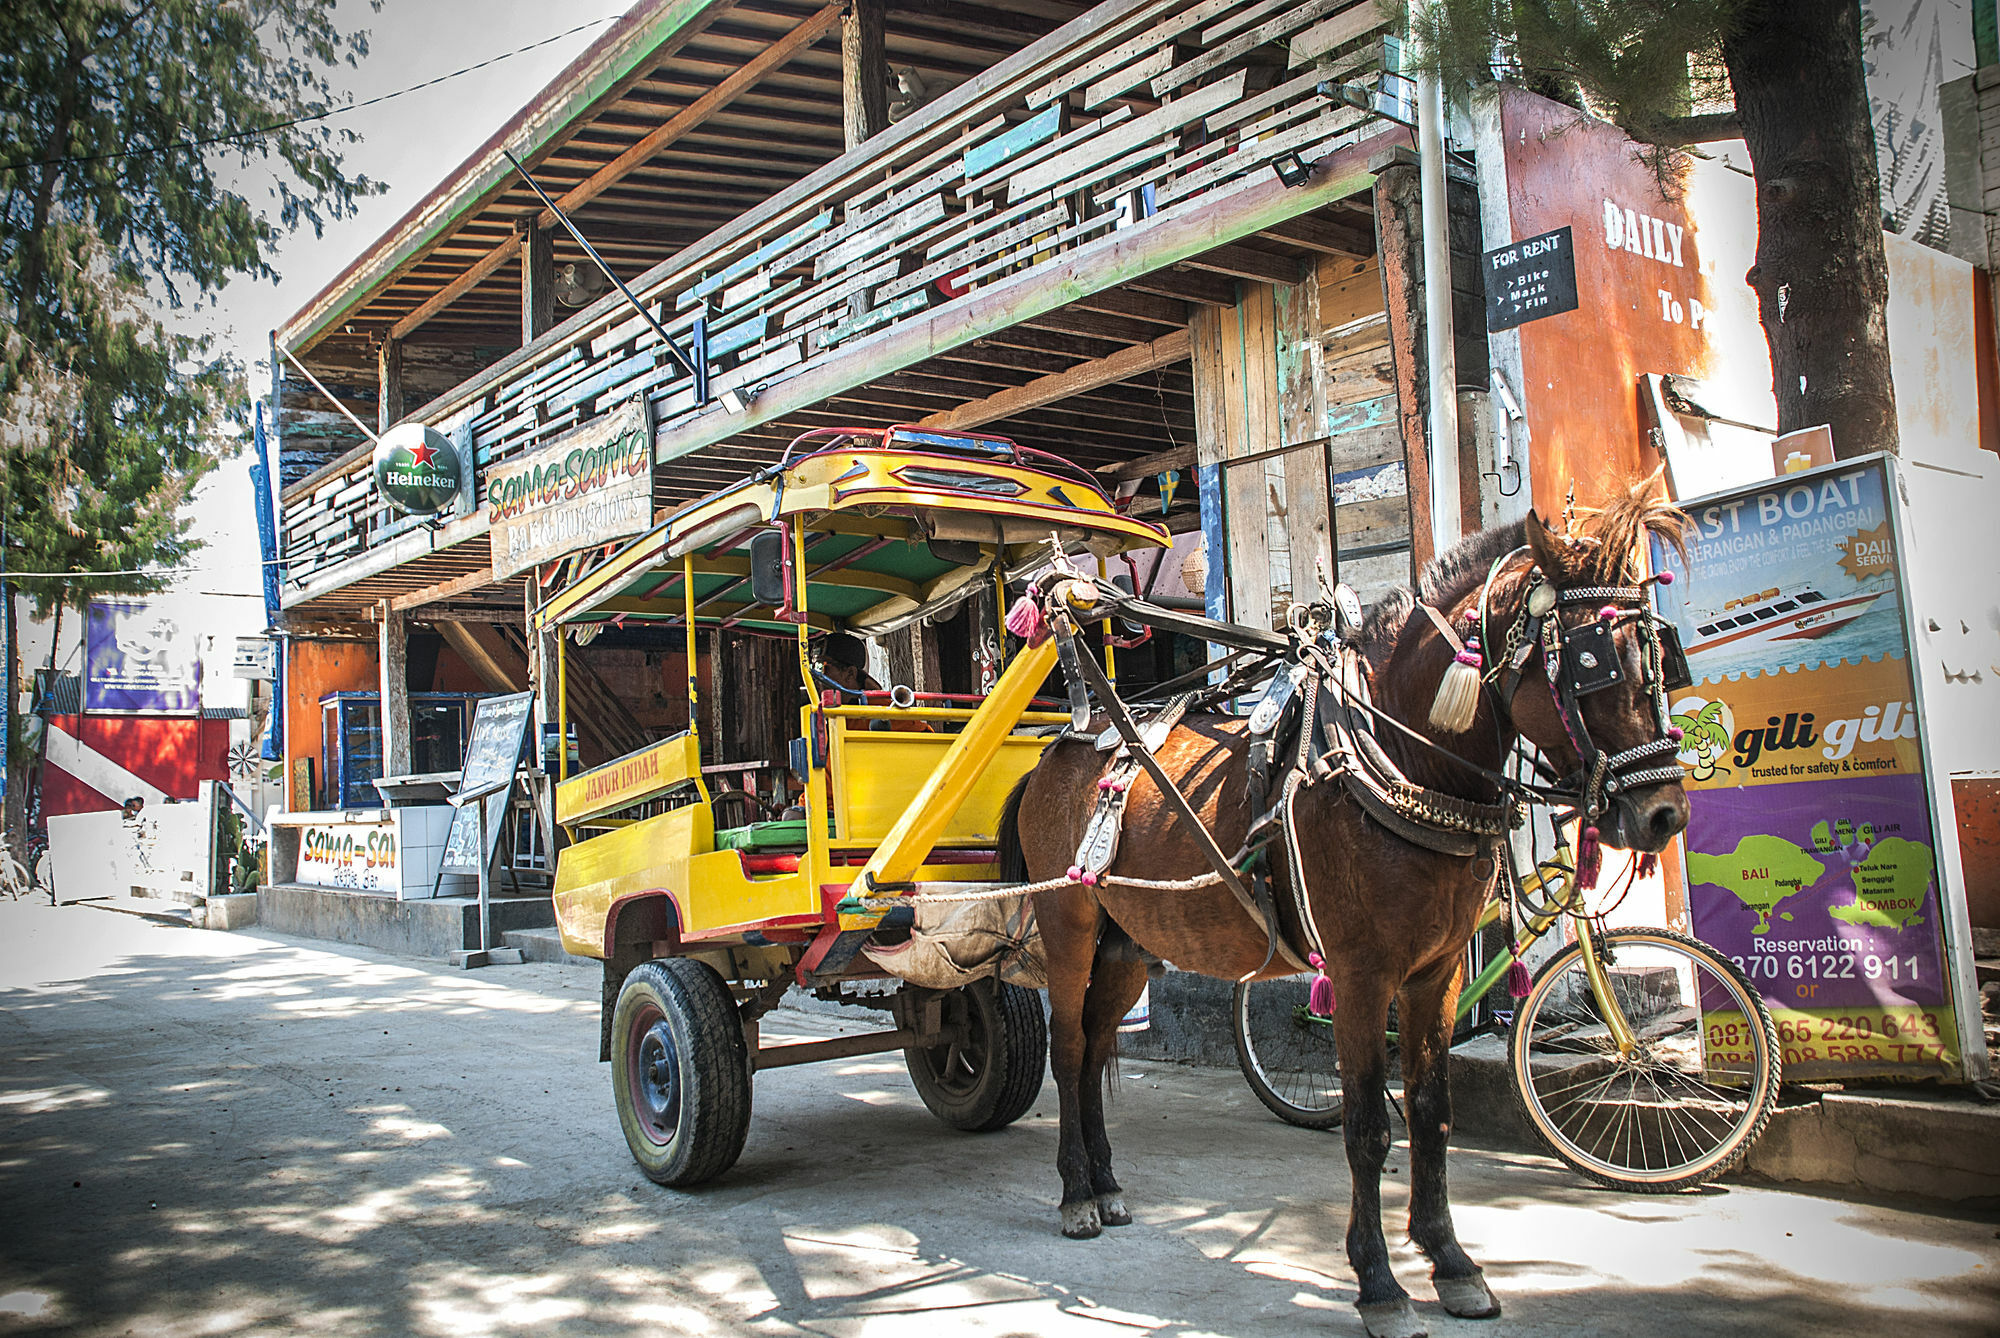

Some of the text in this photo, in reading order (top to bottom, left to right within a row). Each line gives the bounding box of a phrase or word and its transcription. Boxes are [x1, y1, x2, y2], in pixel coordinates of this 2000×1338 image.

[1603, 198, 1684, 268] DAILY
[1492, 234, 1560, 270] FOR RENT
[1510, 283, 1545, 301] Mask
[1658, 288, 1684, 324] To
[386, 471, 455, 489] Heineken
[1678, 470, 1866, 542] AST BOAT
[507, 520, 541, 556] Bar
[556, 488, 640, 542] Bungalows
[1687, 531, 1766, 565] SERANGAN
[1768, 528, 1780, 546] &
[1782, 506, 1873, 544] PADANGBAI
[1733, 701, 1917, 768] gili gili
[585, 751, 659, 802] JANUR INDAH
[1752, 757, 1897, 778] trusted for safety & comfort
[1863, 823, 1901, 834] GILI AIR
[1742, 867, 1769, 881] BALI
[1860, 897, 1917, 912] LOMBOK
[1753, 936, 1863, 954] Reservation
[1787, 955, 1855, 979] 6122
[1864, 955, 1919, 981] 911
[1796, 983, 1819, 998] or
[1820, 1015, 1872, 1042] 220
[1881, 1012, 1940, 1040] 643
[1888, 1043, 1947, 1064] 777
